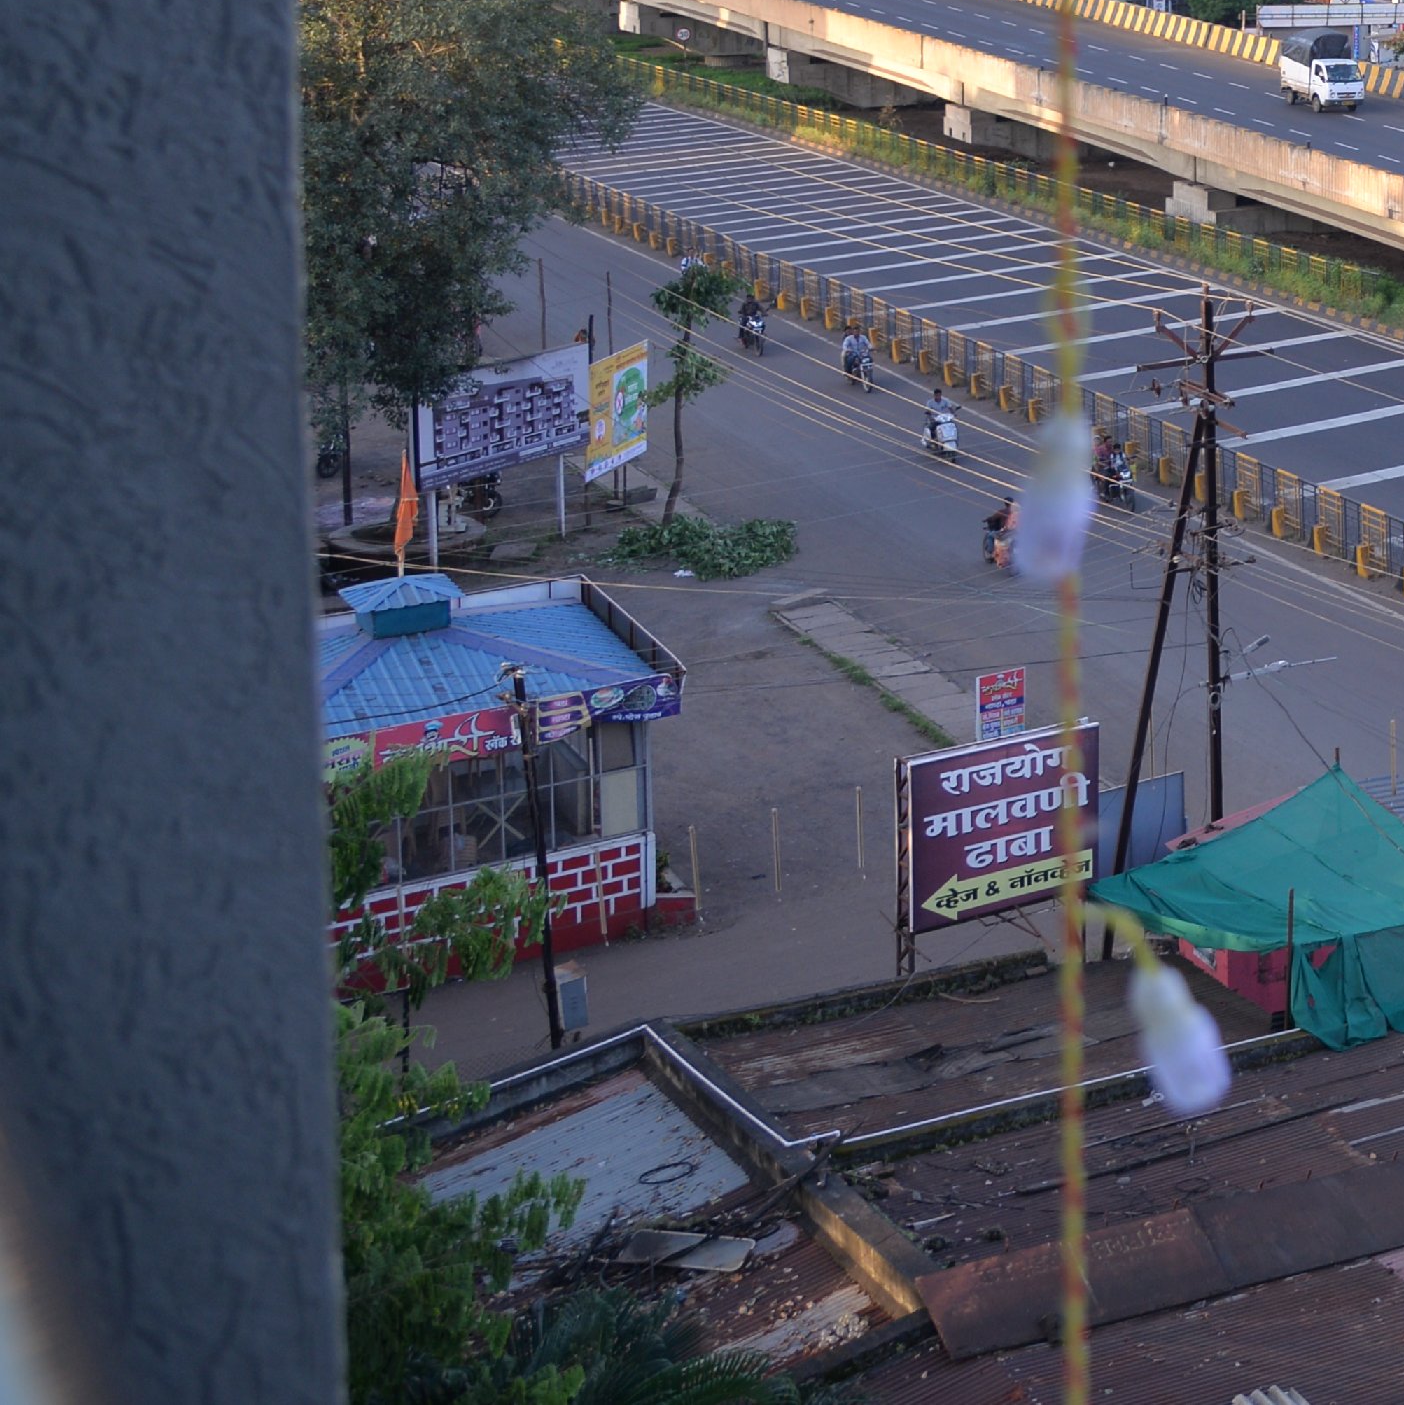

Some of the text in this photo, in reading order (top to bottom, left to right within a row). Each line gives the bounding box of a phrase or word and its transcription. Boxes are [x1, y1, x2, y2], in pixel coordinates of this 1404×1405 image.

[940, 744, 1073, 795] राजयोग
[924, 772, 1091, 838] मालवणी
[964, 825, 1054, 869] ढाबा
[935, 859, 1091, 910] व्हेज & नॉनव्हेज
